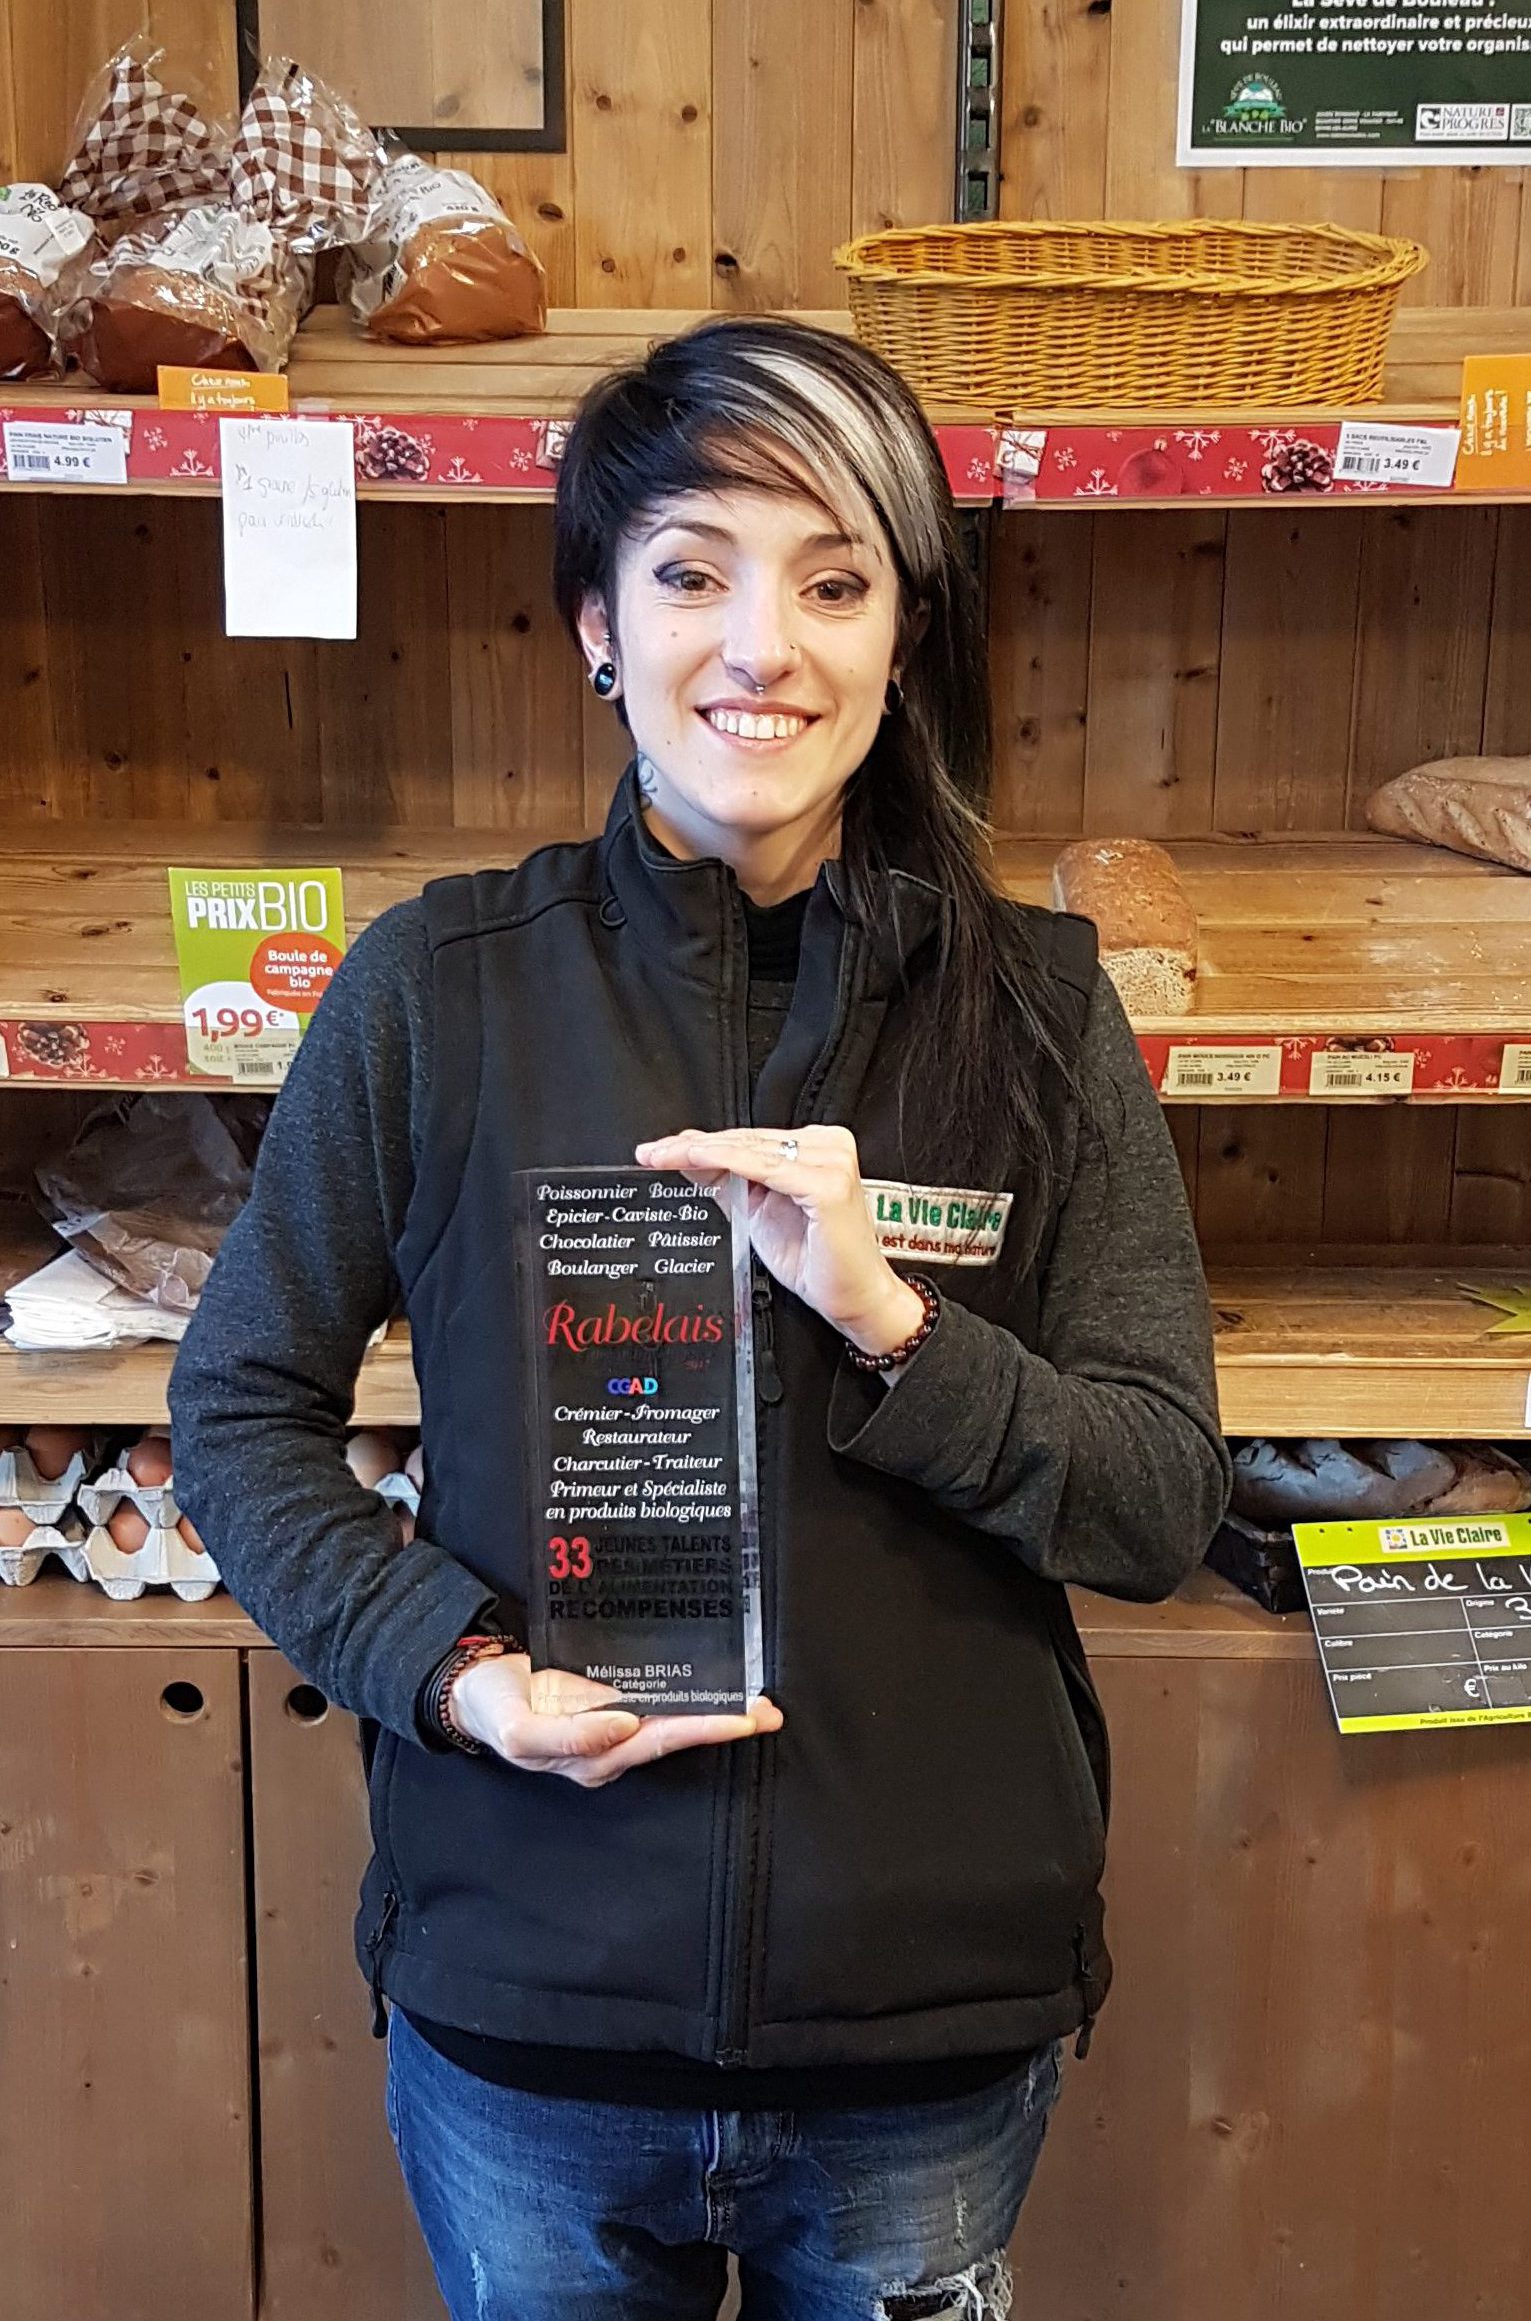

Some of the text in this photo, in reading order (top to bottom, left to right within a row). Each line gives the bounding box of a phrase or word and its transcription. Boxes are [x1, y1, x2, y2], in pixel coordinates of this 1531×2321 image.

[1247, 17, 1269, 30] un
[1273, 13, 1315, 30] élixir
[1319, 13, 1440, 30] extraordinaire
[1443, 15, 1461, 30] et
[1220, 35, 1248, 55] qui
[1252, 37, 1313, 55] permet
[1316, 36, 1338, 52] de
[1342, 38, 1415, 55] nettoyer
[1418, 38, 1463, 52] votre
[1443, 107, 1492, 118] NATURE
[54, 455, 91, 468] 4.99 €
[1384, 458, 1420, 471] 3.49 €
[185, 881, 256, 897] LES PETITS
[187, 881, 328, 932] PRIX BIO
[268, 949, 328, 963] Boule de
[264, 964, 333, 978] campagne
[289, 976, 311, 988] bio
[192, 1008, 264, 1043] 1,99
[1217, 1072, 1251, 1082] 3.49 €
[1365, 1072, 1401, 1082] 4.15 €
[537, 1181, 721, 1201] Poissonnier Boucher
[876, 1194, 1002, 1232] La Vie Claire
[539, 1230, 722, 1250] Chocolatier Pâtissier
[881, 1234, 905, 1249] est
[908, 1234, 941, 1253] dans
[944, 1242, 962, 1256] ma
[547, 1258, 715, 1280] Boulanger Glacier
[543, 1299, 726, 1353] Rabelais
[607, 1378, 659, 1395] CGAD
[582, 1428, 692, 1446] Restaurateur
[550, 1479, 728, 1502] Primeur et Spécialiste
[545, 1501, 732, 1524] en produits biologiques
[594, 1535, 731, 1554] JEUNES TALENTS
[1409, 1527, 1503, 1546] La Vie Claire
[549, 1536, 593, 1579] 33
[1332, 1565, 1416, 1593] Pain
[1424, 1562, 1469, 1591] de
[1476, 1562, 1513, 1590] la
[549, 1598, 734, 1620] RECOMPENSES
[1465, 1600, 1495, 1608] Origine
[586, 1664, 693, 1679] Mélissa BRIAS
[1484, 1664, 1500, 1672] Prix
[1512, 1663, 1528, 1671] kilo
[612, 1679, 667, 1690] Catégorie
[1464, 1679, 1480, 1698] €
[652, 1690, 690, 1704] produits
[690, 1690, 744, 1705] biologiques
[1420, 1717, 1448, 1725] Produit
[1450, 1716, 1466, 1724] issu
[1479, 1712, 1525, 1722] l'Agriculture
